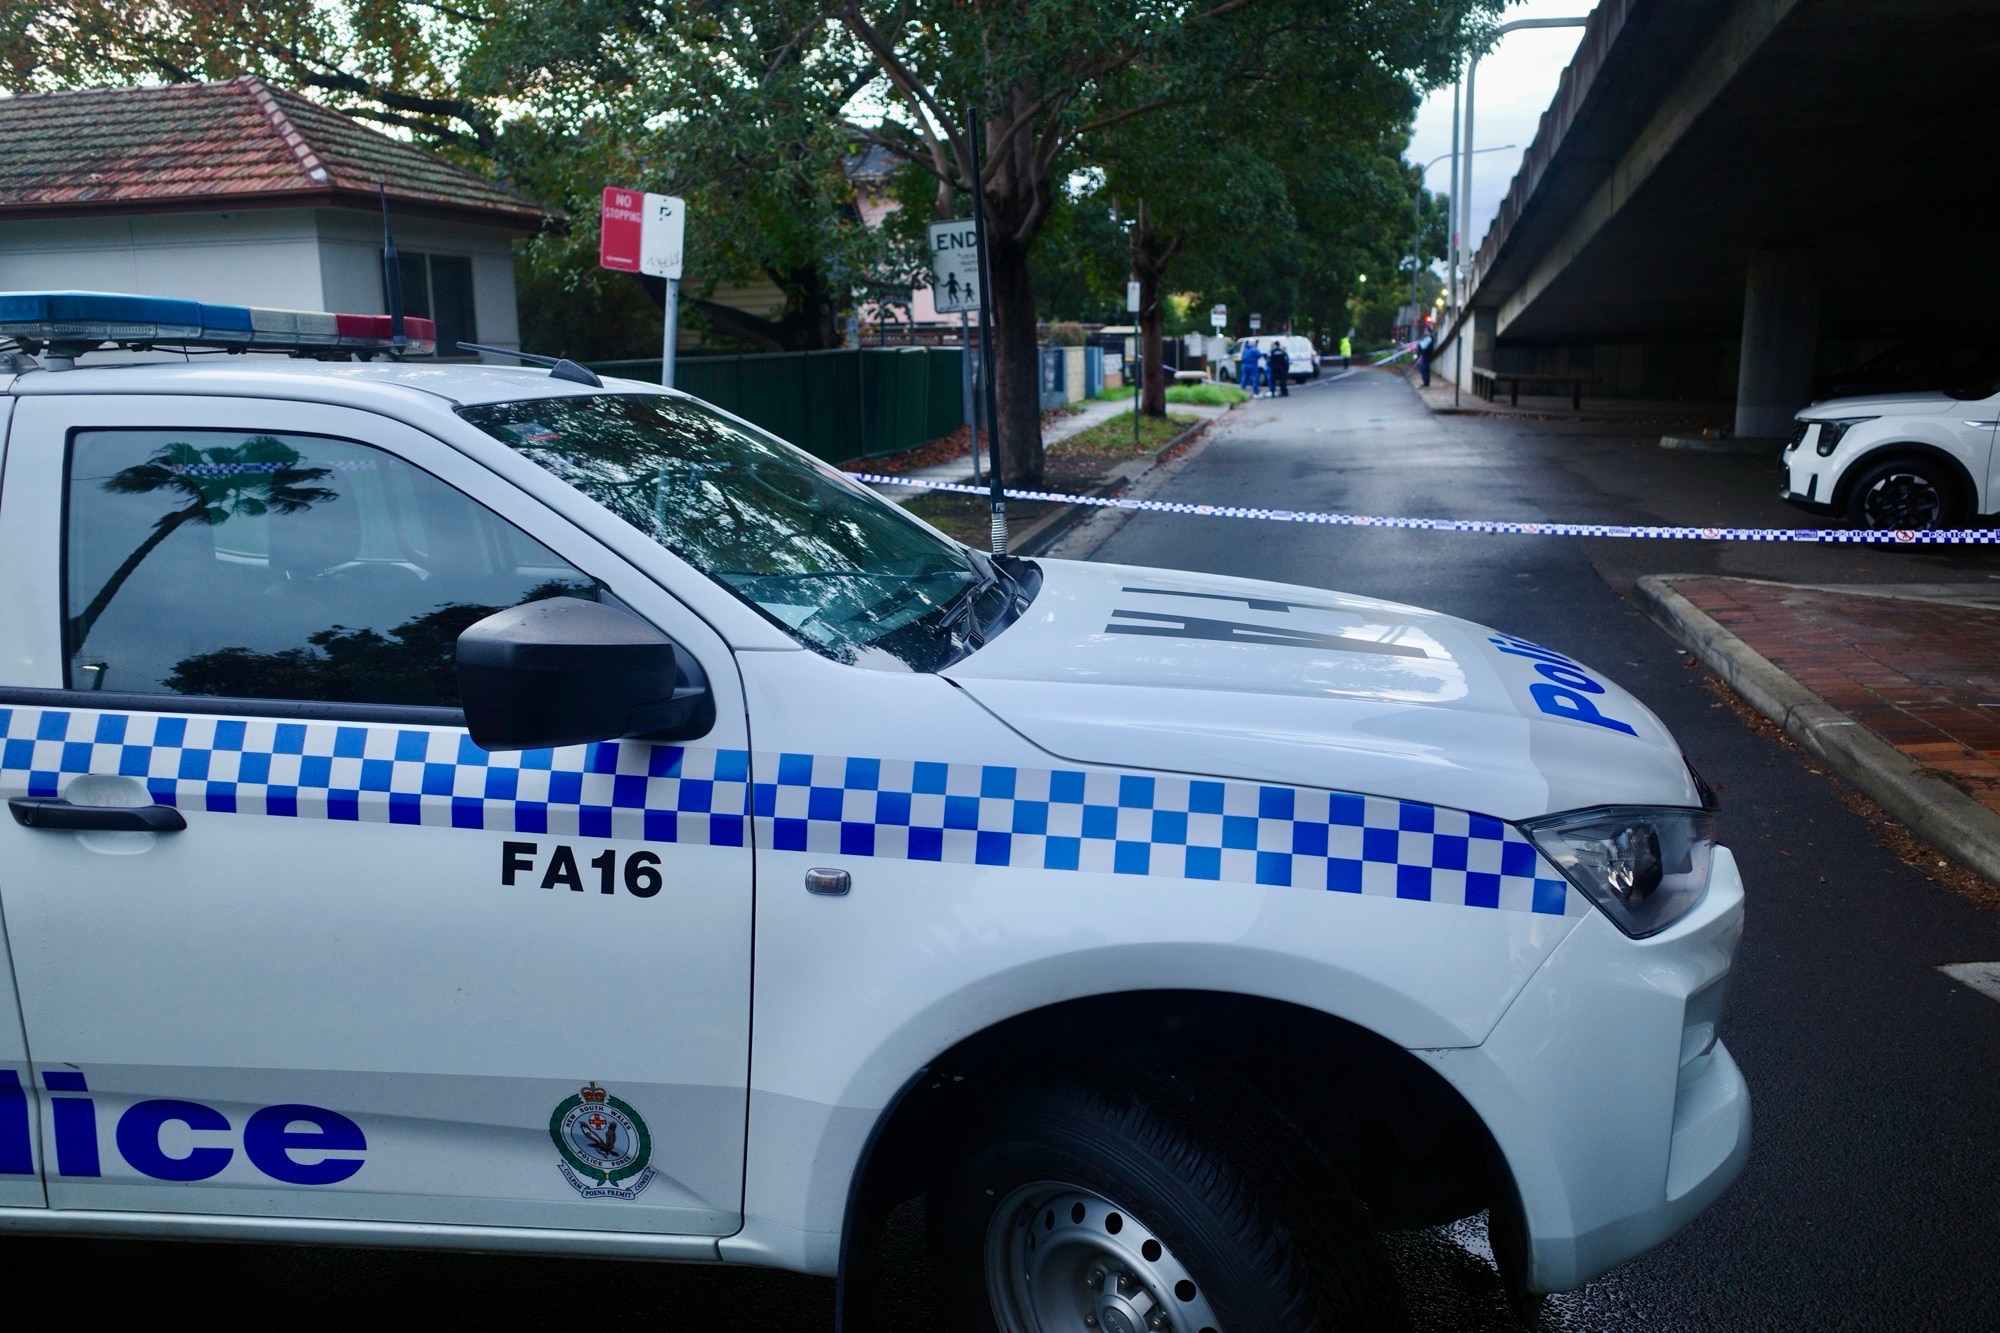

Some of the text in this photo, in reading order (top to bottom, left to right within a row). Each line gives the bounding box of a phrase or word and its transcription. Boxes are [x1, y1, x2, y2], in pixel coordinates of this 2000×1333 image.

[616, 193, 632, 208] NO
[605, 206, 642, 223] STOPPING
[936, 231, 977, 250] END
[1487, 632, 1640, 738] Poli
[502, 841, 663, 899] FA16
[0, 1069, 368, 1186] lice
[566, 1105, 632, 1131] NEW SOUTH WALES
[577, 1150, 632, 1167] POLICE FORCE
[563, 1168, 583, 1190] CULPAM
[607, 1189, 632, 1199] PREMIT
